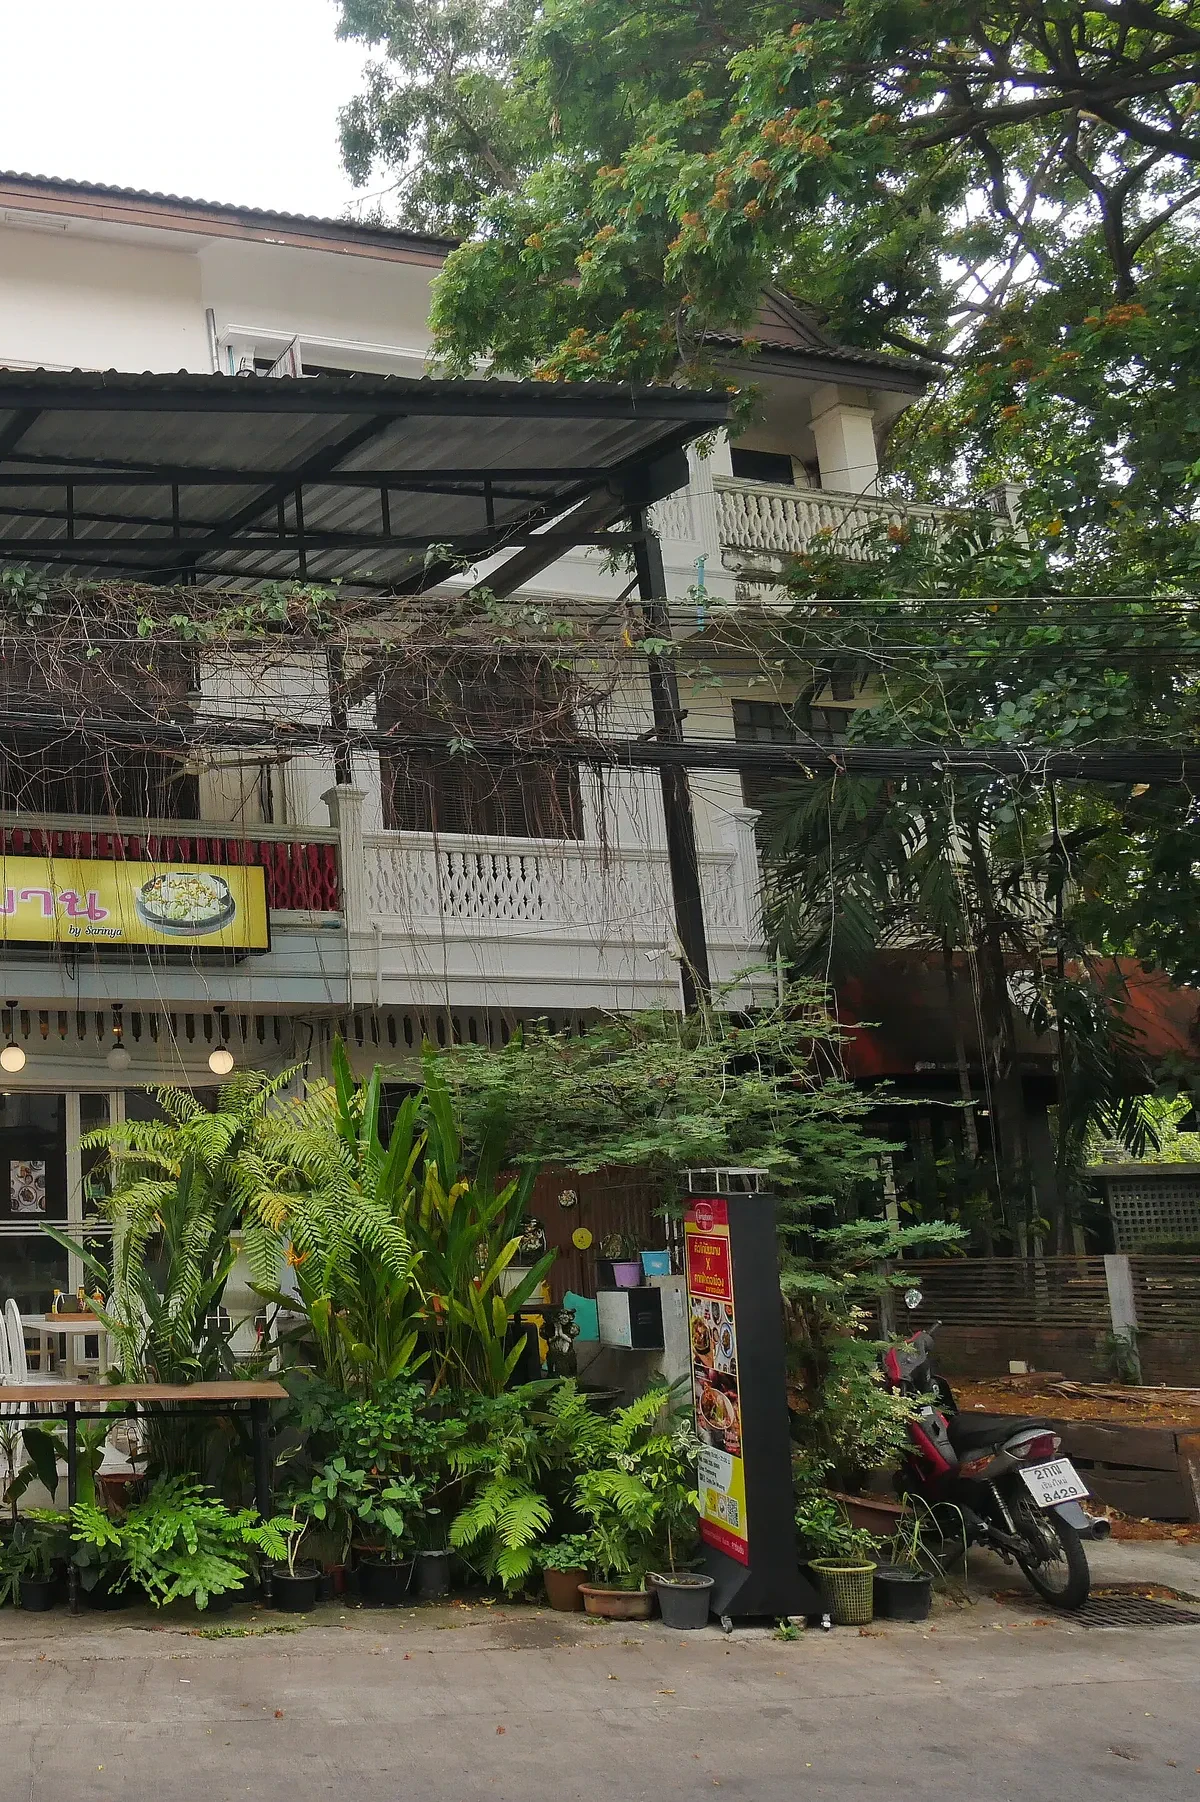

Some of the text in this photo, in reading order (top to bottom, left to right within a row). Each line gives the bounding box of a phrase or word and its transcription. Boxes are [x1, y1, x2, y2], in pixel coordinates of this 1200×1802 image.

[68, 924, 123, 939] by Sarinya
[1043, 1486, 1078, 1503] 8429
